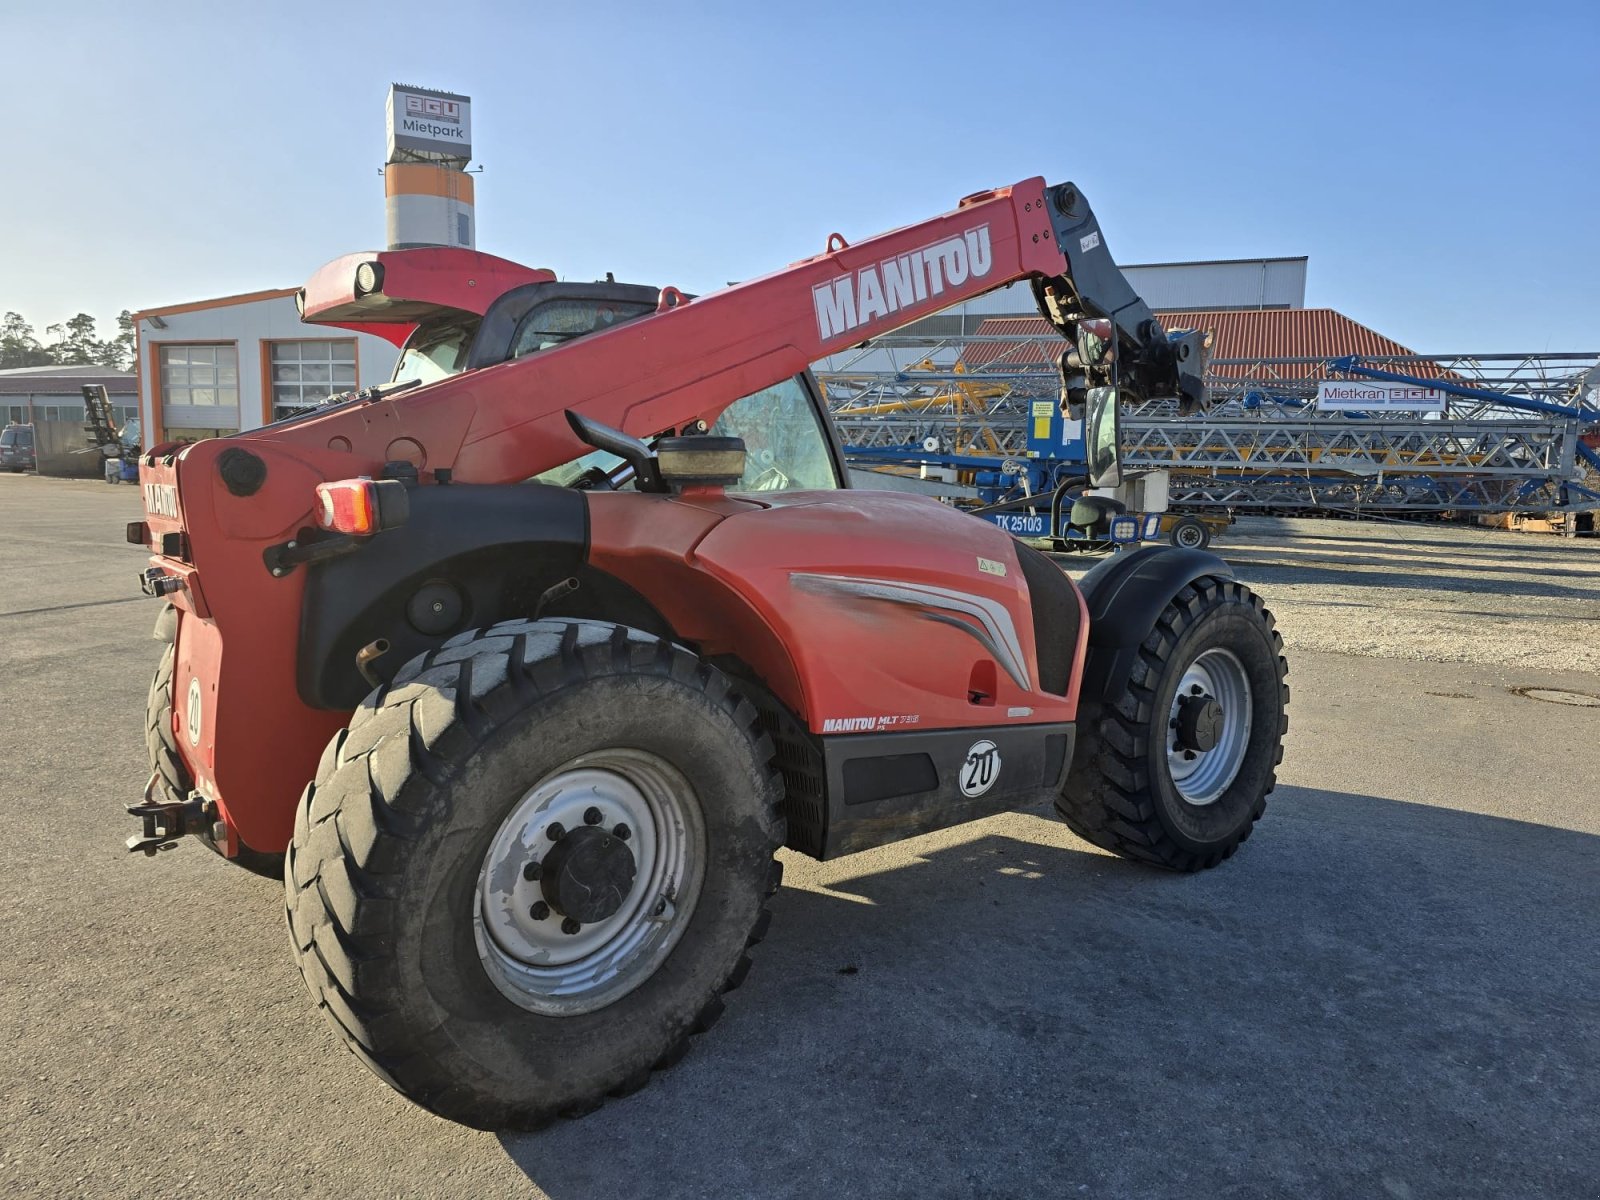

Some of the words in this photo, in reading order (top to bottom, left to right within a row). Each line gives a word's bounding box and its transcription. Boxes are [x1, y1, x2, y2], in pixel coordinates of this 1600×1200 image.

[405, 95, 460, 119] BGU
[403, 119, 464, 138] Mietpark
[812, 222, 993, 344] MANITOU
[1324, 387, 1385, 399] Mietkran
[995, 515, 1009, 531] TK
[1011, 515, 1043, 532] 2510/3
[823, 716, 876, 732] MANITOU
[878, 715, 899, 725] MLT
[965, 751, 994, 790] 20
